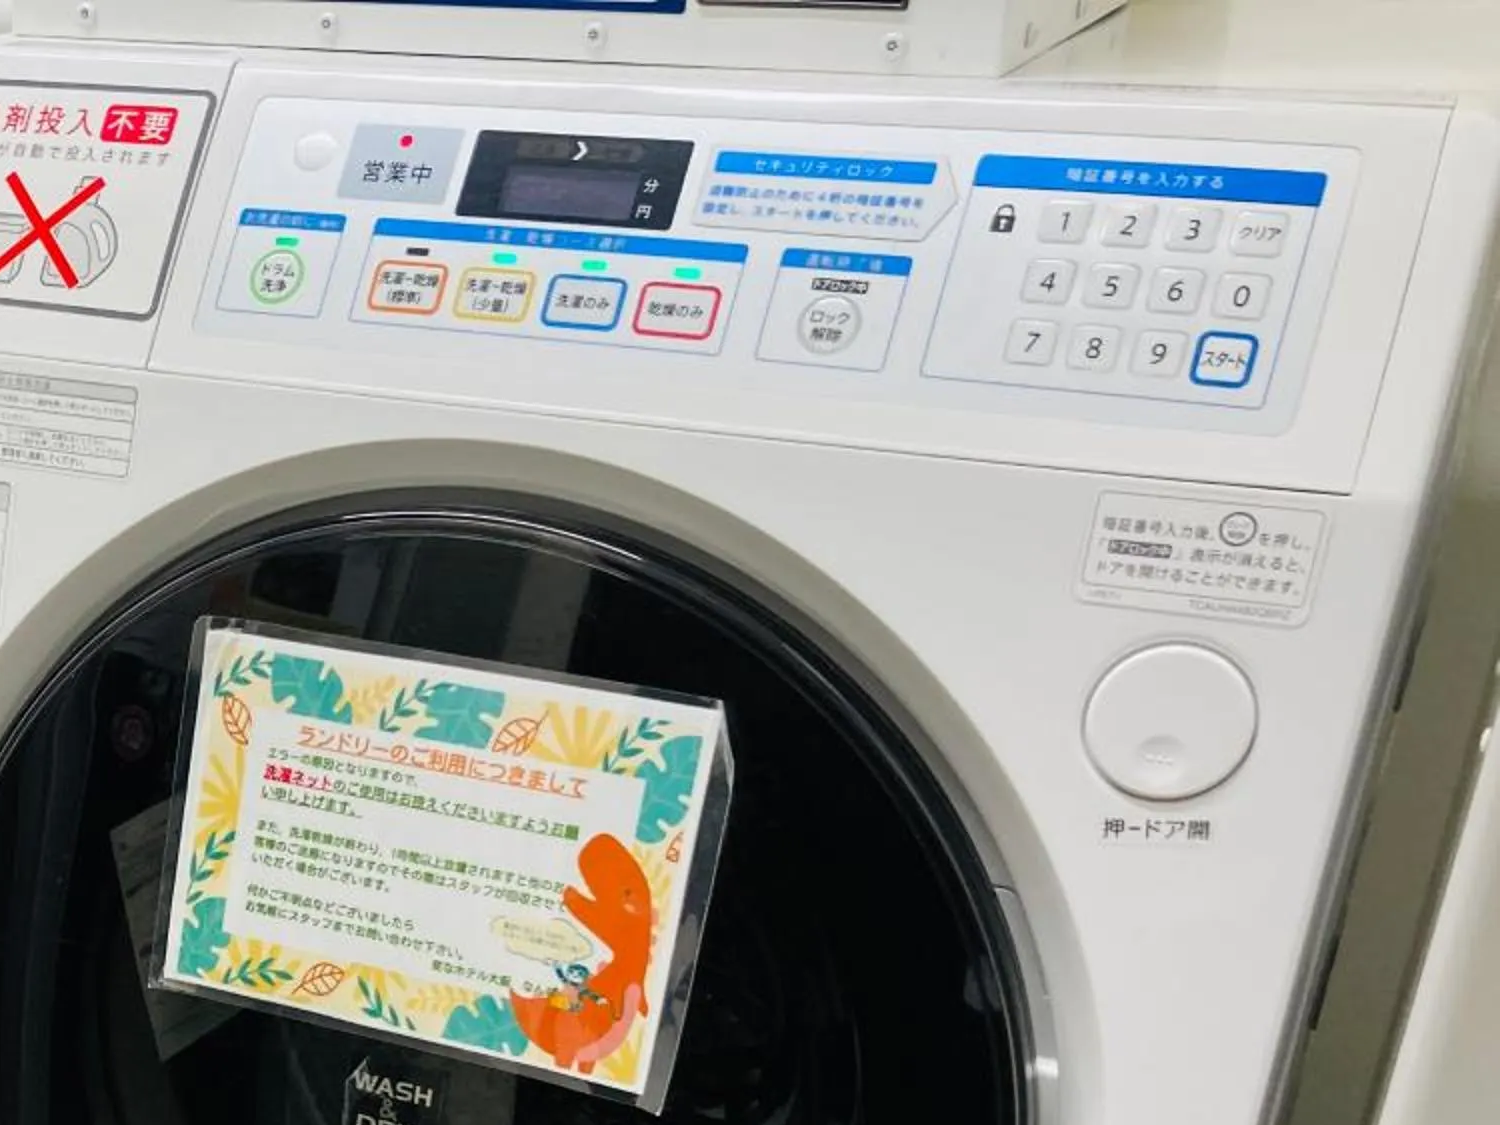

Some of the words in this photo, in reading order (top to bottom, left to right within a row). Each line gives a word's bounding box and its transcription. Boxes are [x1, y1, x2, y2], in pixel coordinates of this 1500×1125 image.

[107, 110, 174, 142] 不要
[363, 159, 433, 185] 営業中
[754, 159, 894, 179] セキュリティロック
[1066, 167, 1225, 190] 暗証番号を入力する
[643, 178, 660, 194] 分
[635, 205, 652, 220] 円
[1061, 212, 1071, 232] 1
[1119, 215, 1138, 236] 2
[1185, 219, 1201, 241] 3
[1238, 225, 1282, 242] クリア
[261, 262, 295, 278] ドラム
[1040, 272, 1057, 292] 4
[1103, 275, 1119, 298] 5
[1167, 280, 1184, 302] 6
[1233, 285, 1251, 308] 0
[556, 293, 610, 311] 洗濯のみ
[647, 301, 704, 319] 乾燥のみ
[810, 309, 850, 325] ロック
[1024, 332, 1041, 352] 7
[1085, 337, 1103, 360] 8
[1150, 342, 1167, 365] 9
[1202, 351, 1245, 368] スタート
[297, 725, 588, 799] ランドリーのご利用につきまして
[355, 1072, 433, 1107] WASH
[380, 1097, 397, 1121] &
